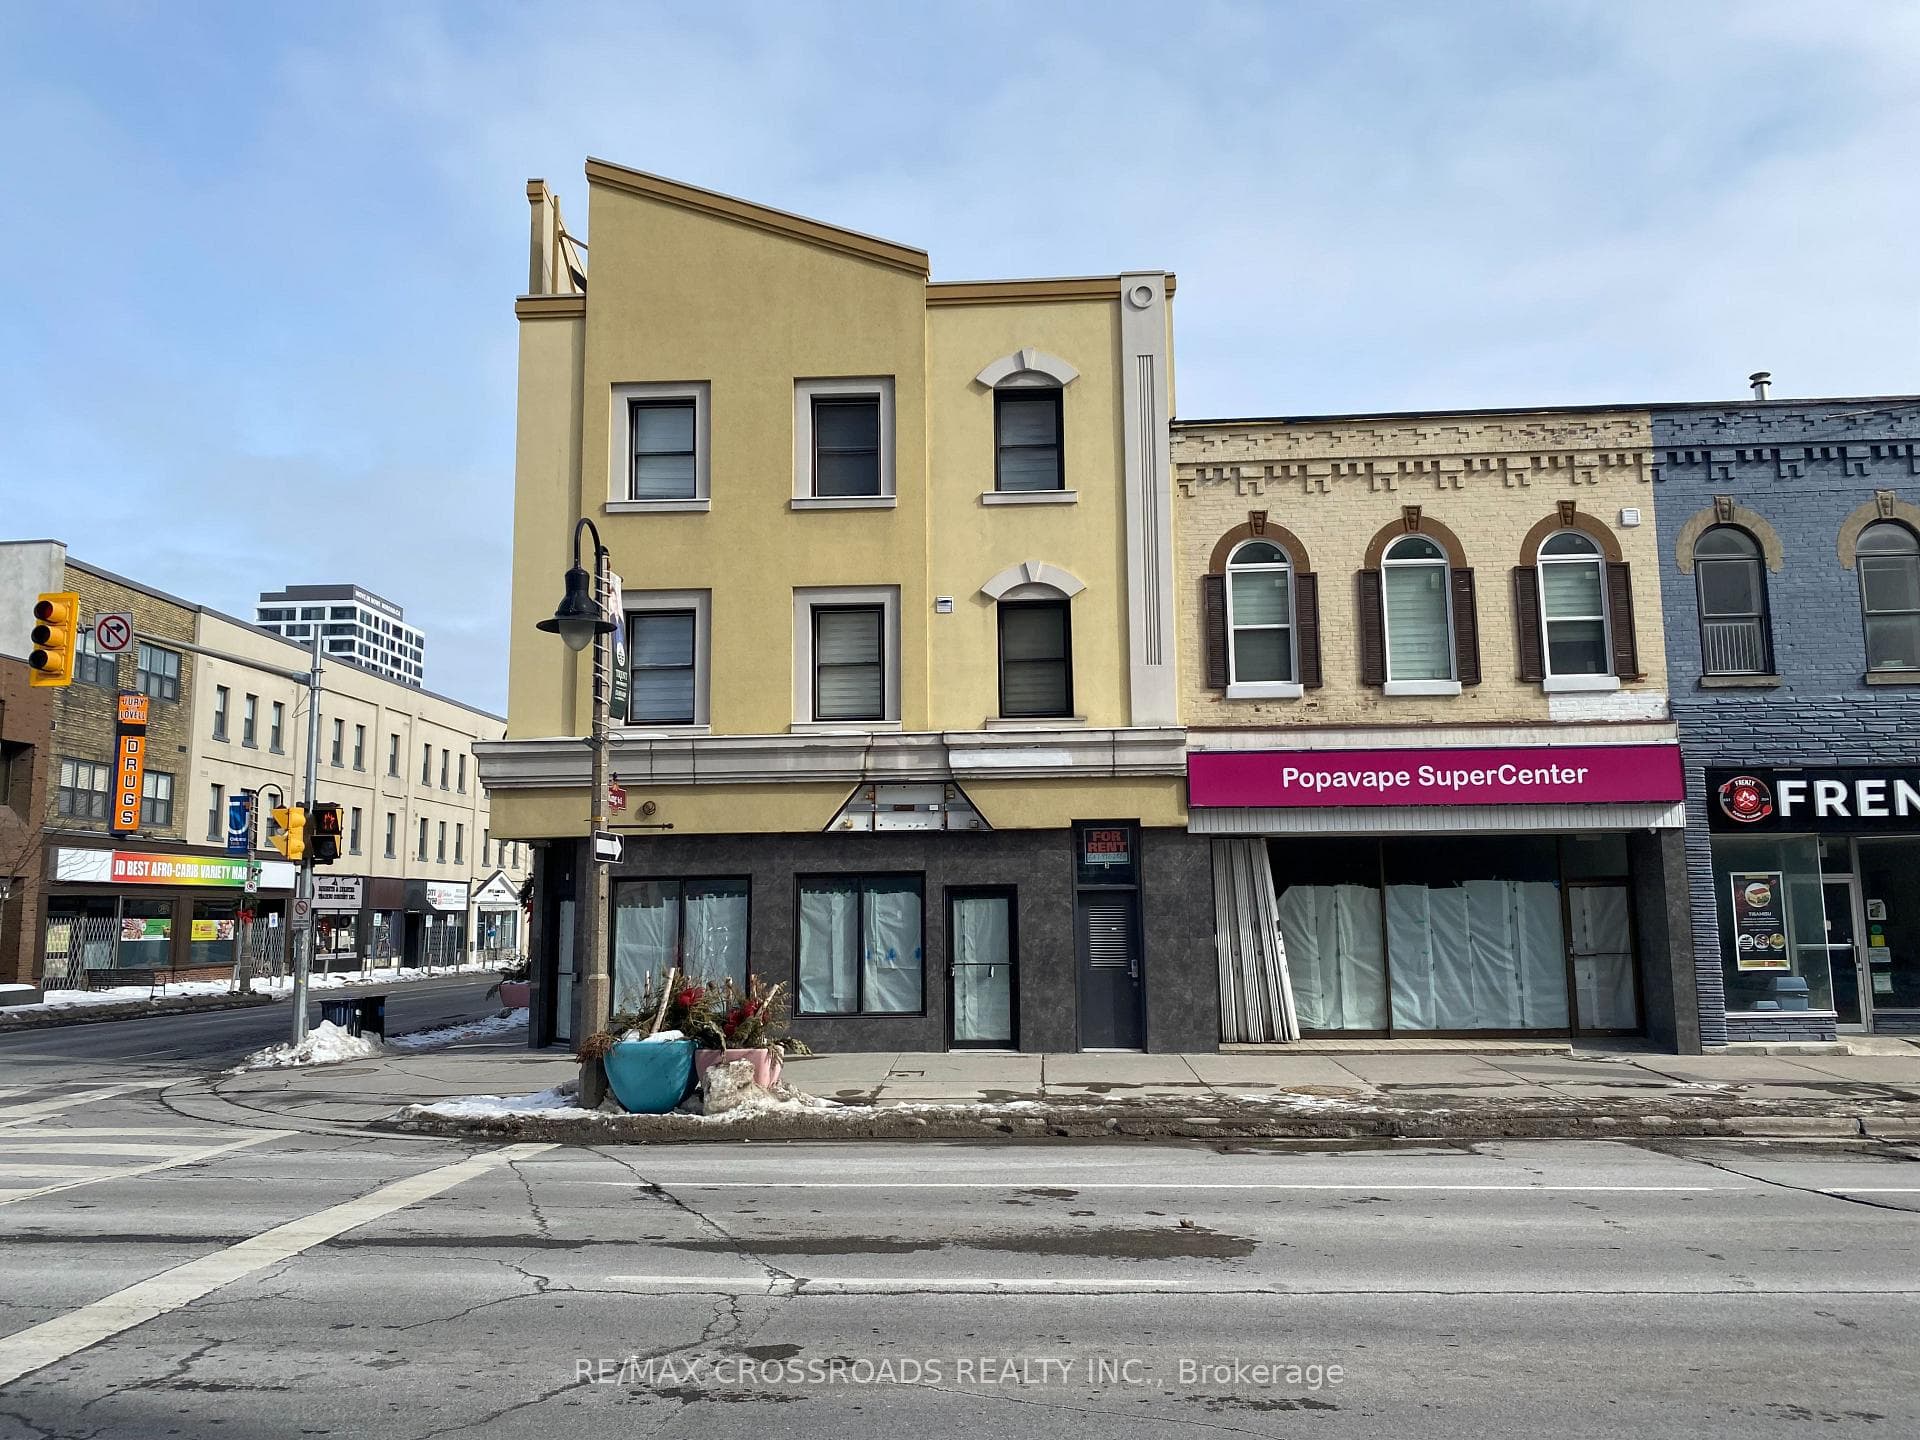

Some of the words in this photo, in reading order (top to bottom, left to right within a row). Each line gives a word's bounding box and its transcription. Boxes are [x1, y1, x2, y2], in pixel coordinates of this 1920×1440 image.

[121, 739, 140, 825] DRUGS
[1282, 767, 1410, 792] Popavape
[1418, 764, 1588, 791] SuperCenter
[1734, 779, 1756, 787] FRENZY
[1776, 779, 1920, 817] FREN
[1088, 841, 1127, 852] RENT
[1092, 831, 1121, 841] FOR
[114, 859, 126, 876] JD
[126, 860, 150, 877] BEST
[150, 861, 199, 879] AFRO-CARIB
[200, 864, 231, 880] VARIETY
